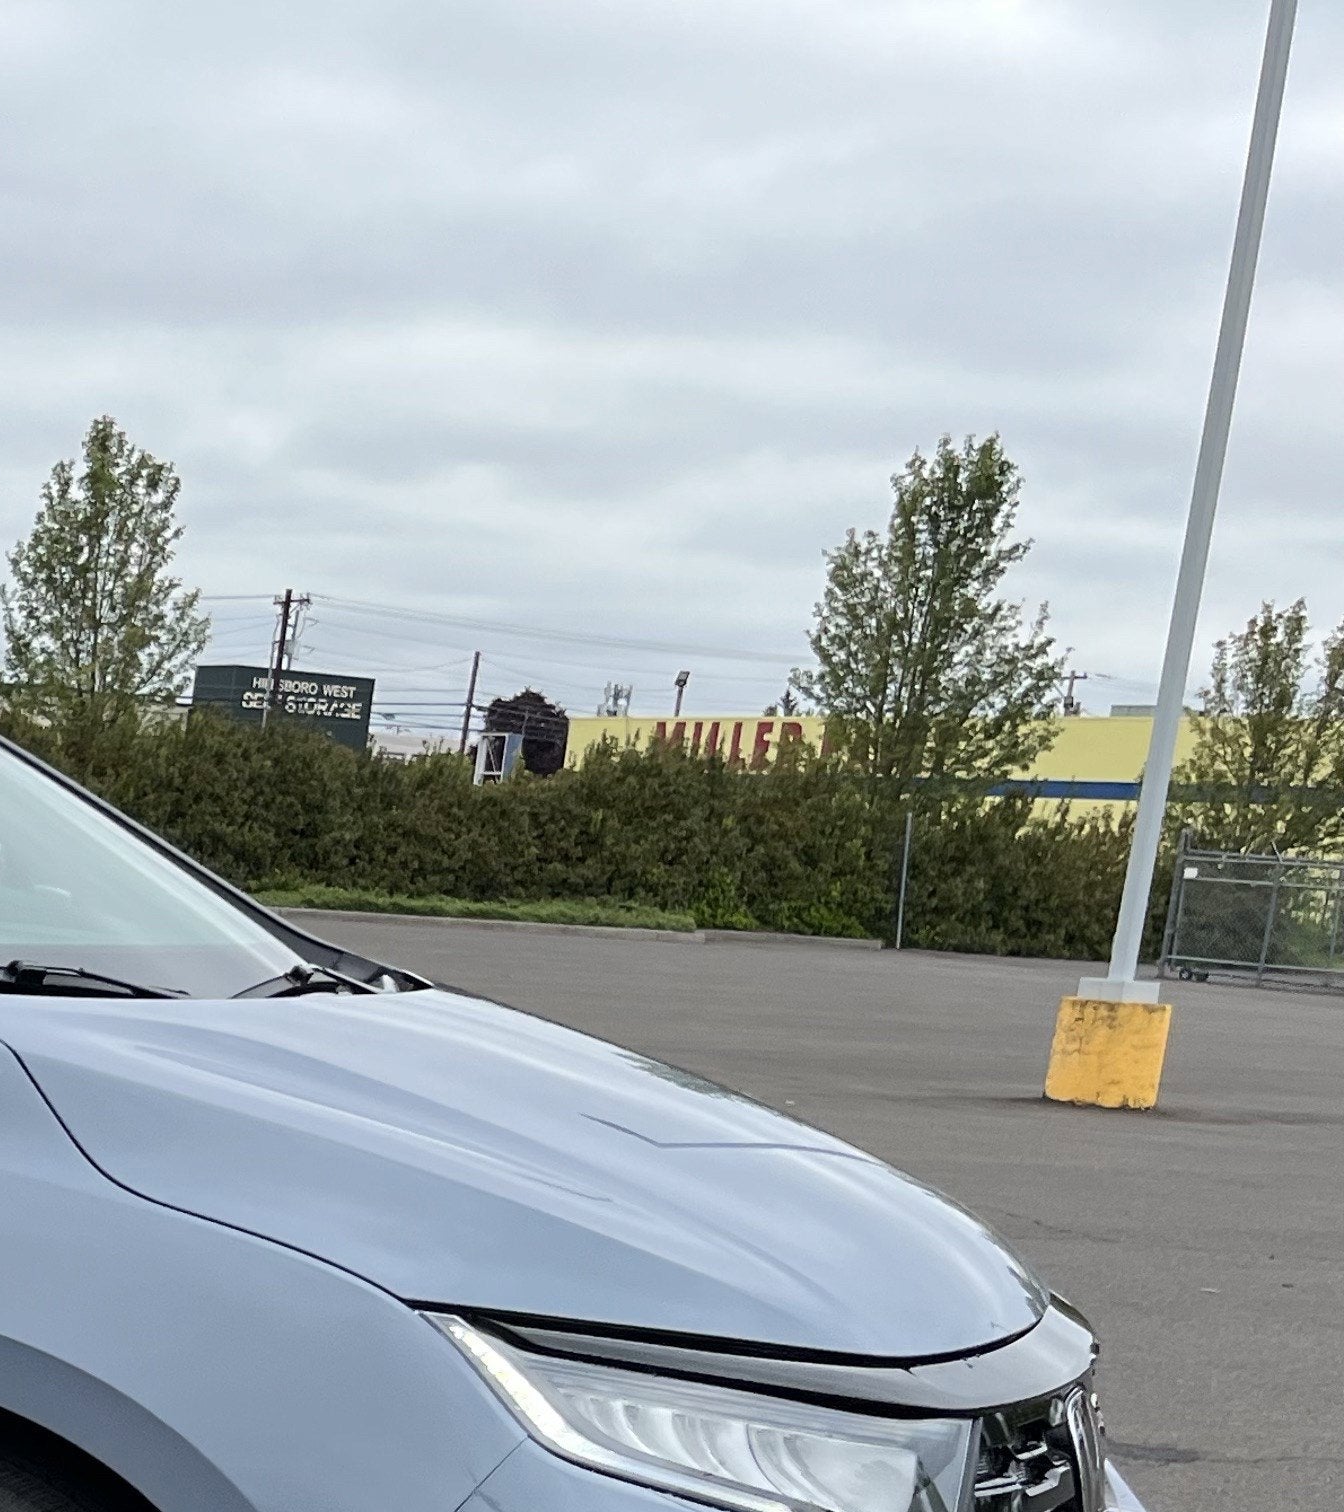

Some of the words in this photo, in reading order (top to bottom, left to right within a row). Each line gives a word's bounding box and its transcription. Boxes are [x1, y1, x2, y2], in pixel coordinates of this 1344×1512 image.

[323, 684, 357, 698] WEST
[242, 691, 283, 709] SEL
[285, 695, 362, 720] STORAGE
